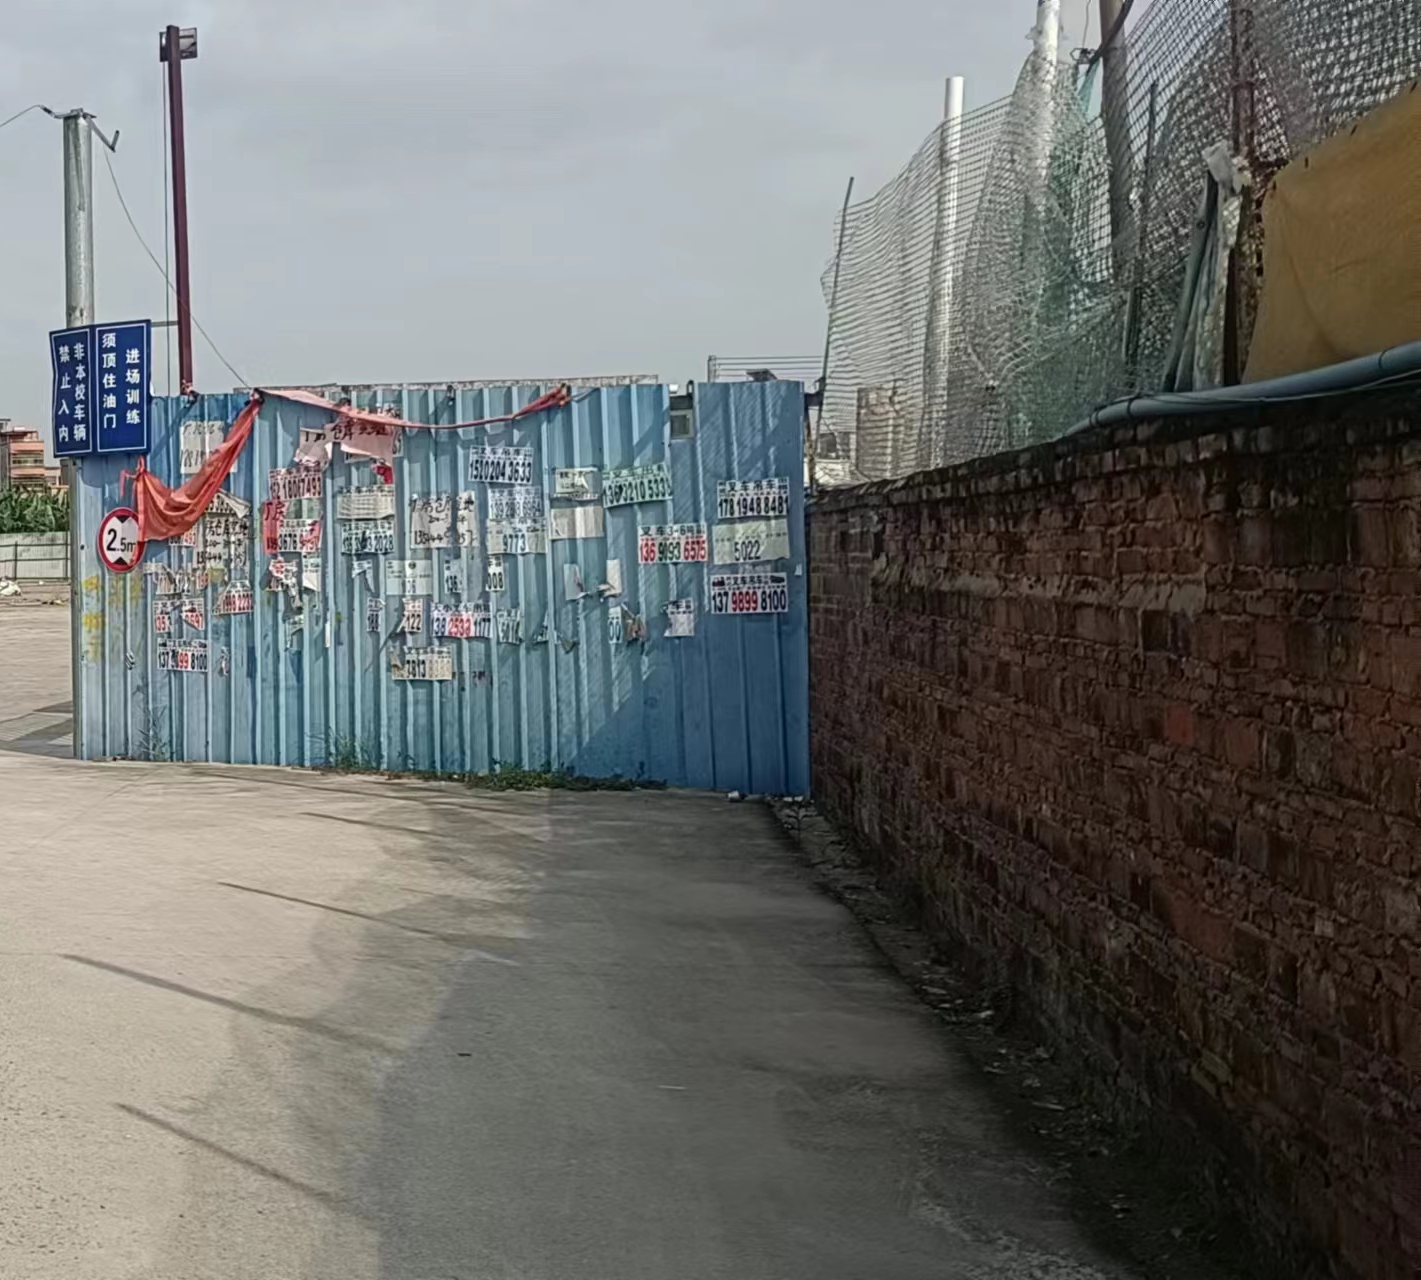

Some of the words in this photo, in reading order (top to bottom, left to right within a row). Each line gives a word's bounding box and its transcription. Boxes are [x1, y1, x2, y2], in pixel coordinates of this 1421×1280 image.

[58, 345, 72, 442] 禁止入内
[73, 342, 87, 441] 非本校车辆
[102, 333, 117, 429] 须顶住油门
[125, 348, 141, 424] 进场训练
